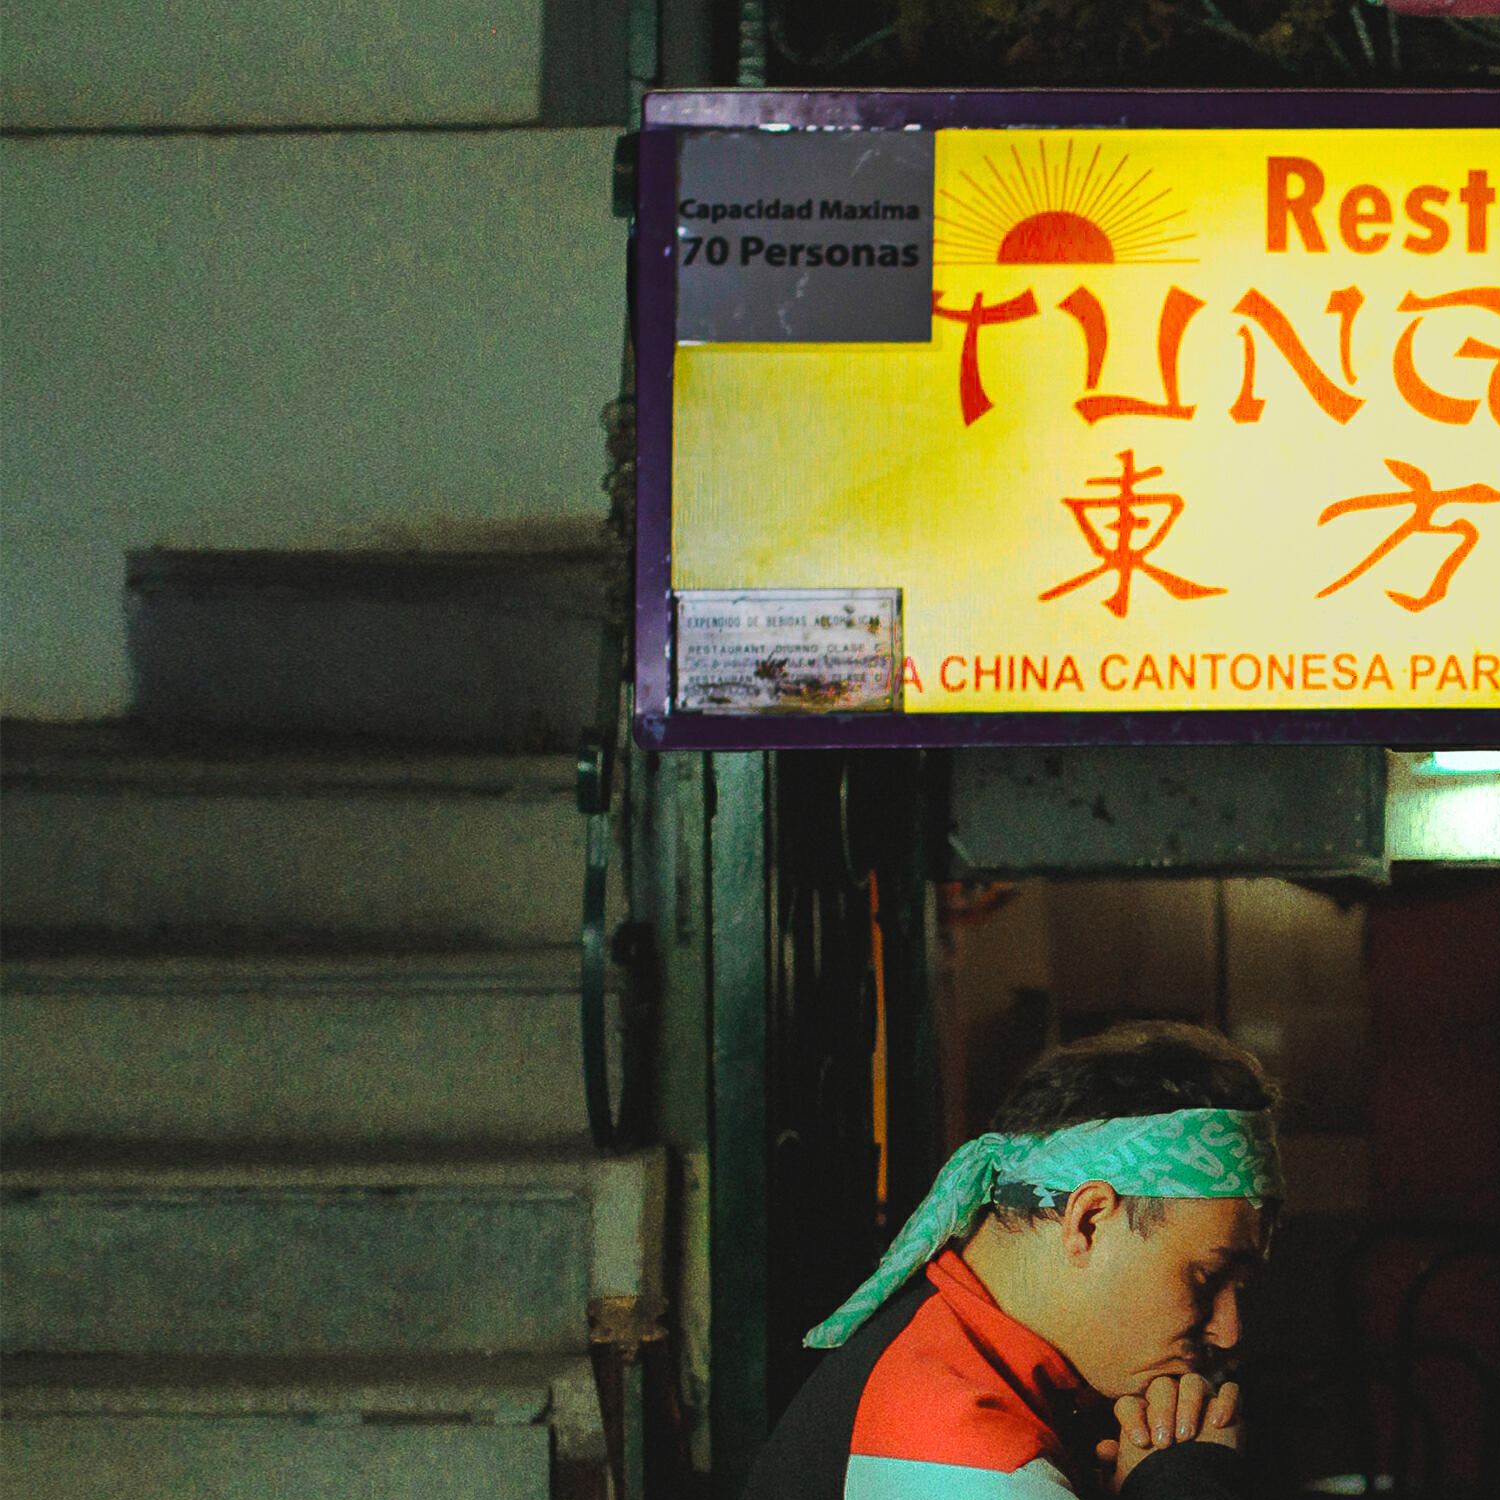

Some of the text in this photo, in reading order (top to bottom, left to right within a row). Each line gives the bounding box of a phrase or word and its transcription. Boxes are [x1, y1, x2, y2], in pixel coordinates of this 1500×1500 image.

[680, 199, 920, 224] Capacidad Maxima
[682, 236, 920, 267] 70 Personas
[687, 615, 741, 628] EXPENDIDO
[747, 615, 758, 627] DE
[766, 615, 807, 627] BEBIDAS
[688, 644, 766, 654] RESTAURANT
[940, 655, 1083, 692] CHINA
[1100, 654, 1392, 691] CANTONESA
